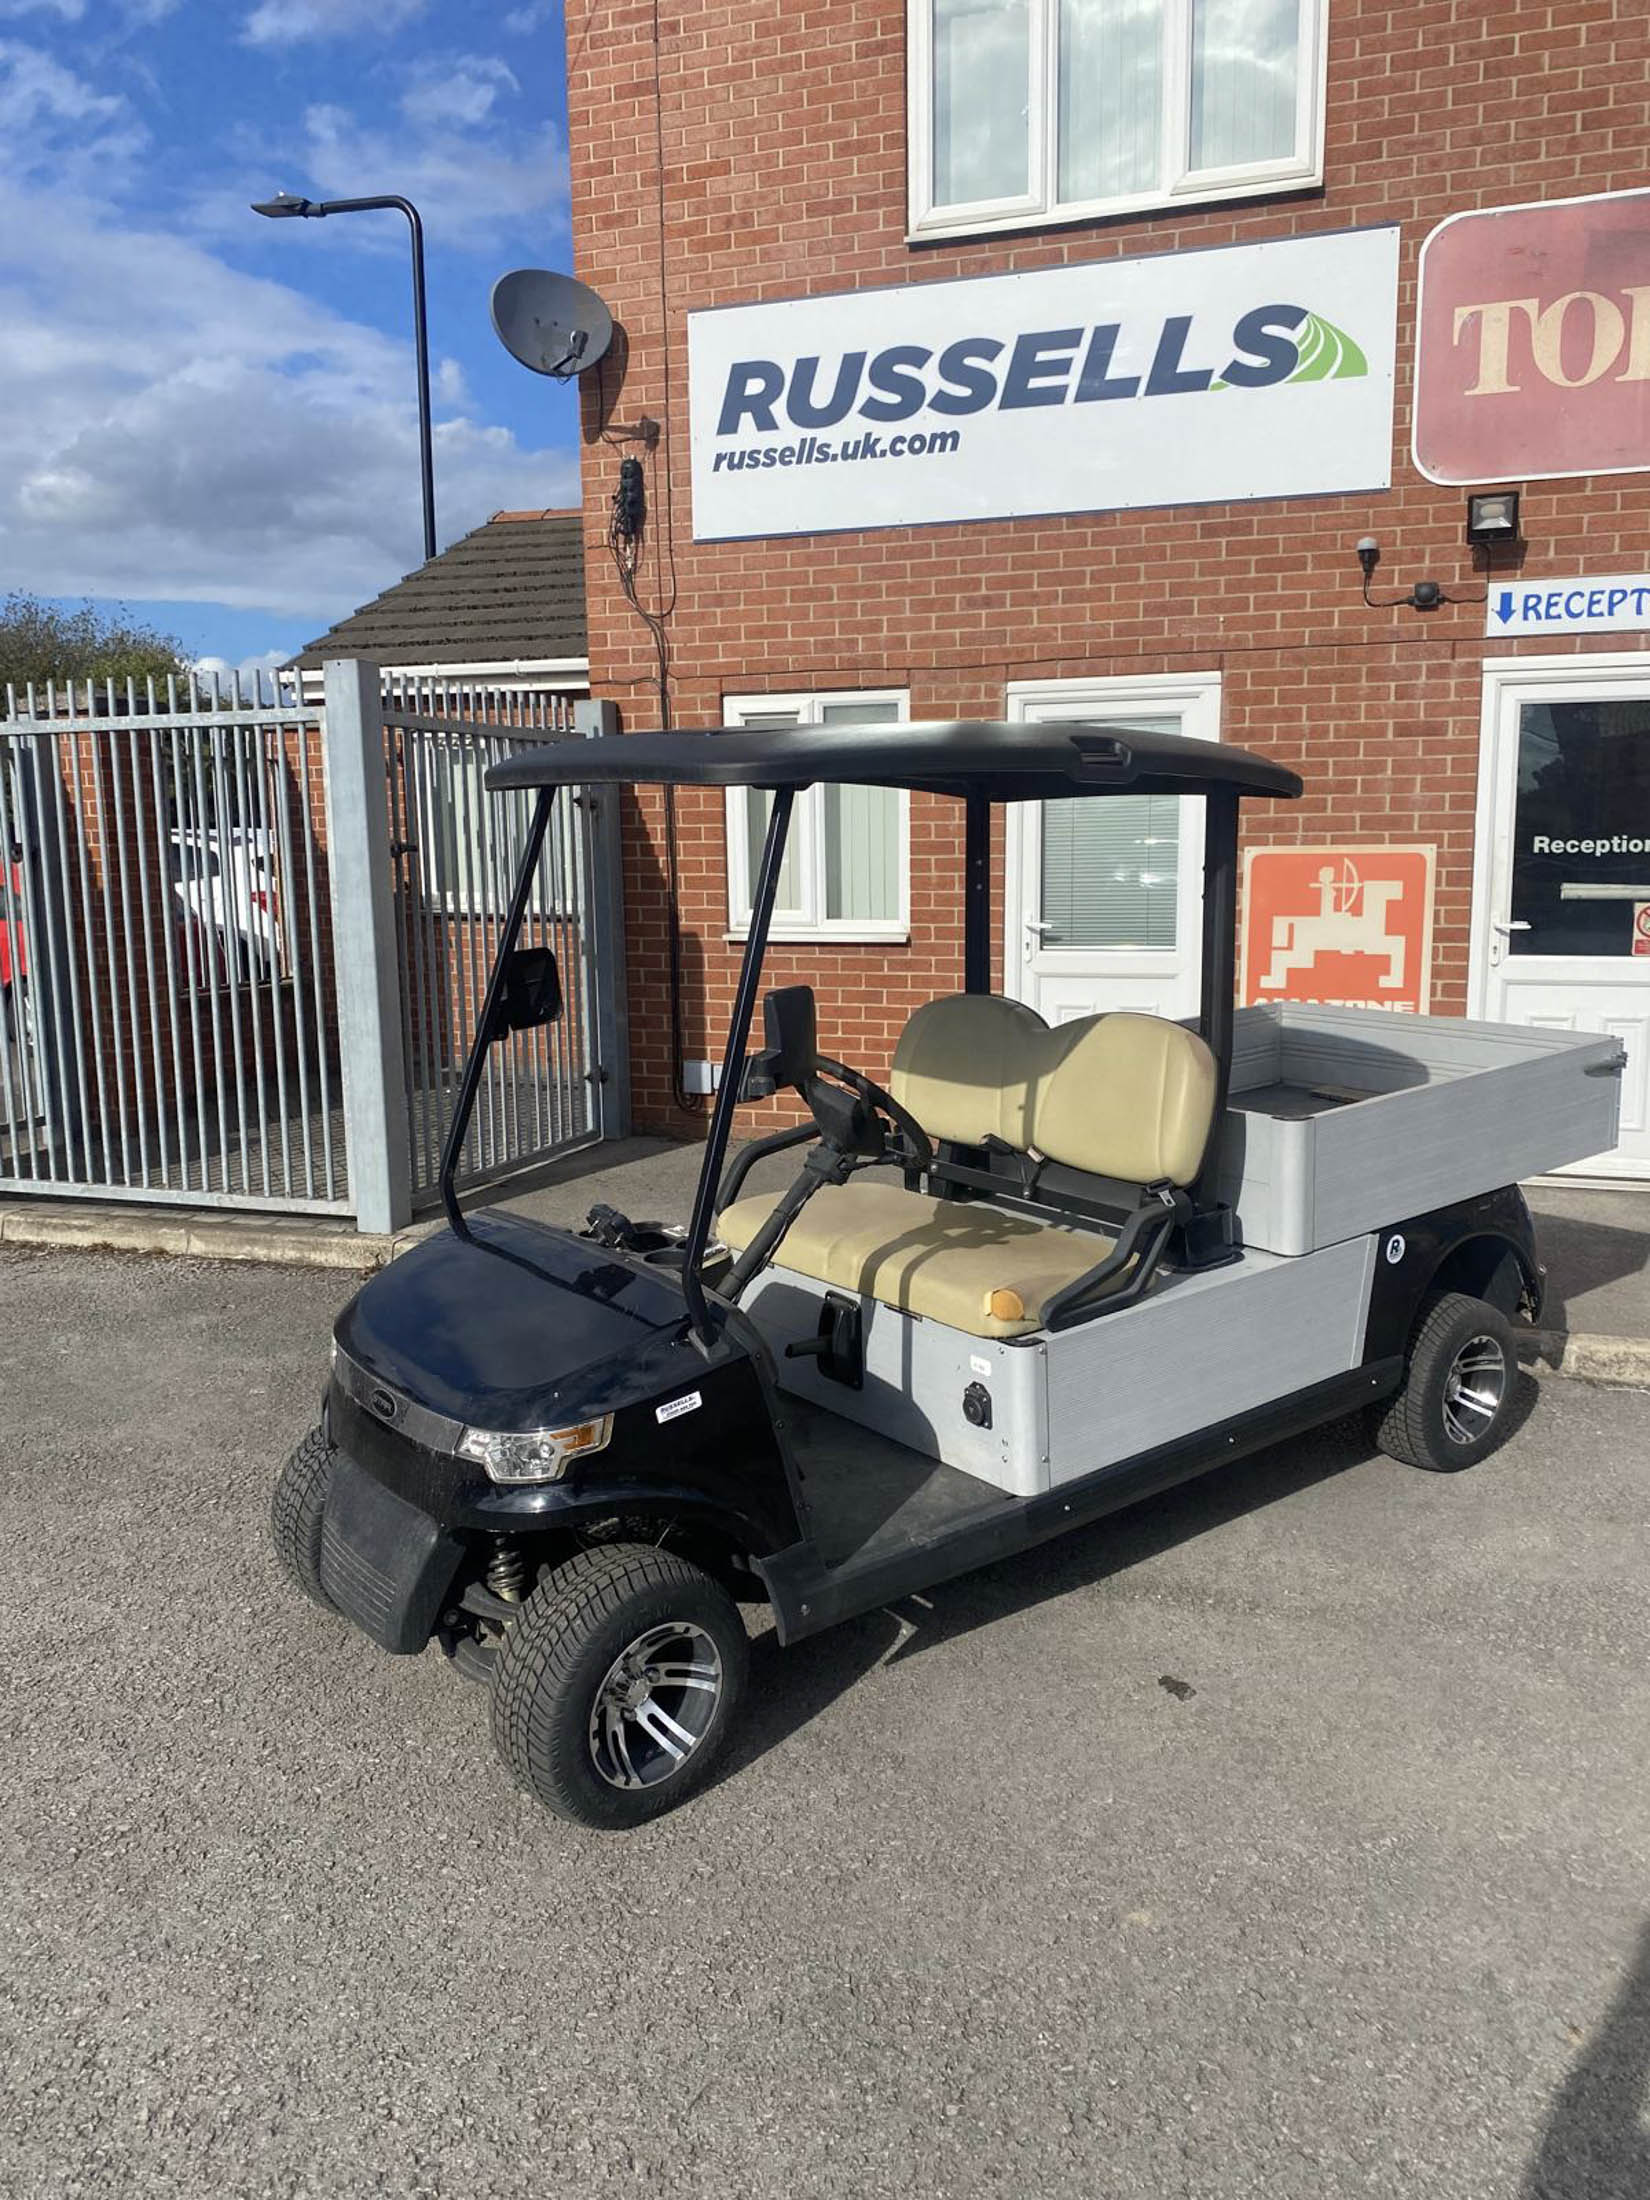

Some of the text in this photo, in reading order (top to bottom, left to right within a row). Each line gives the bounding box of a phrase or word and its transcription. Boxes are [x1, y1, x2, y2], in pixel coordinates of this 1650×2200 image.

[716, 304, 1310, 436] RUSSELLS
[712, 430, 961, 473] russells.uk.com
[1522, 587, 1650, 622] RECEPT
